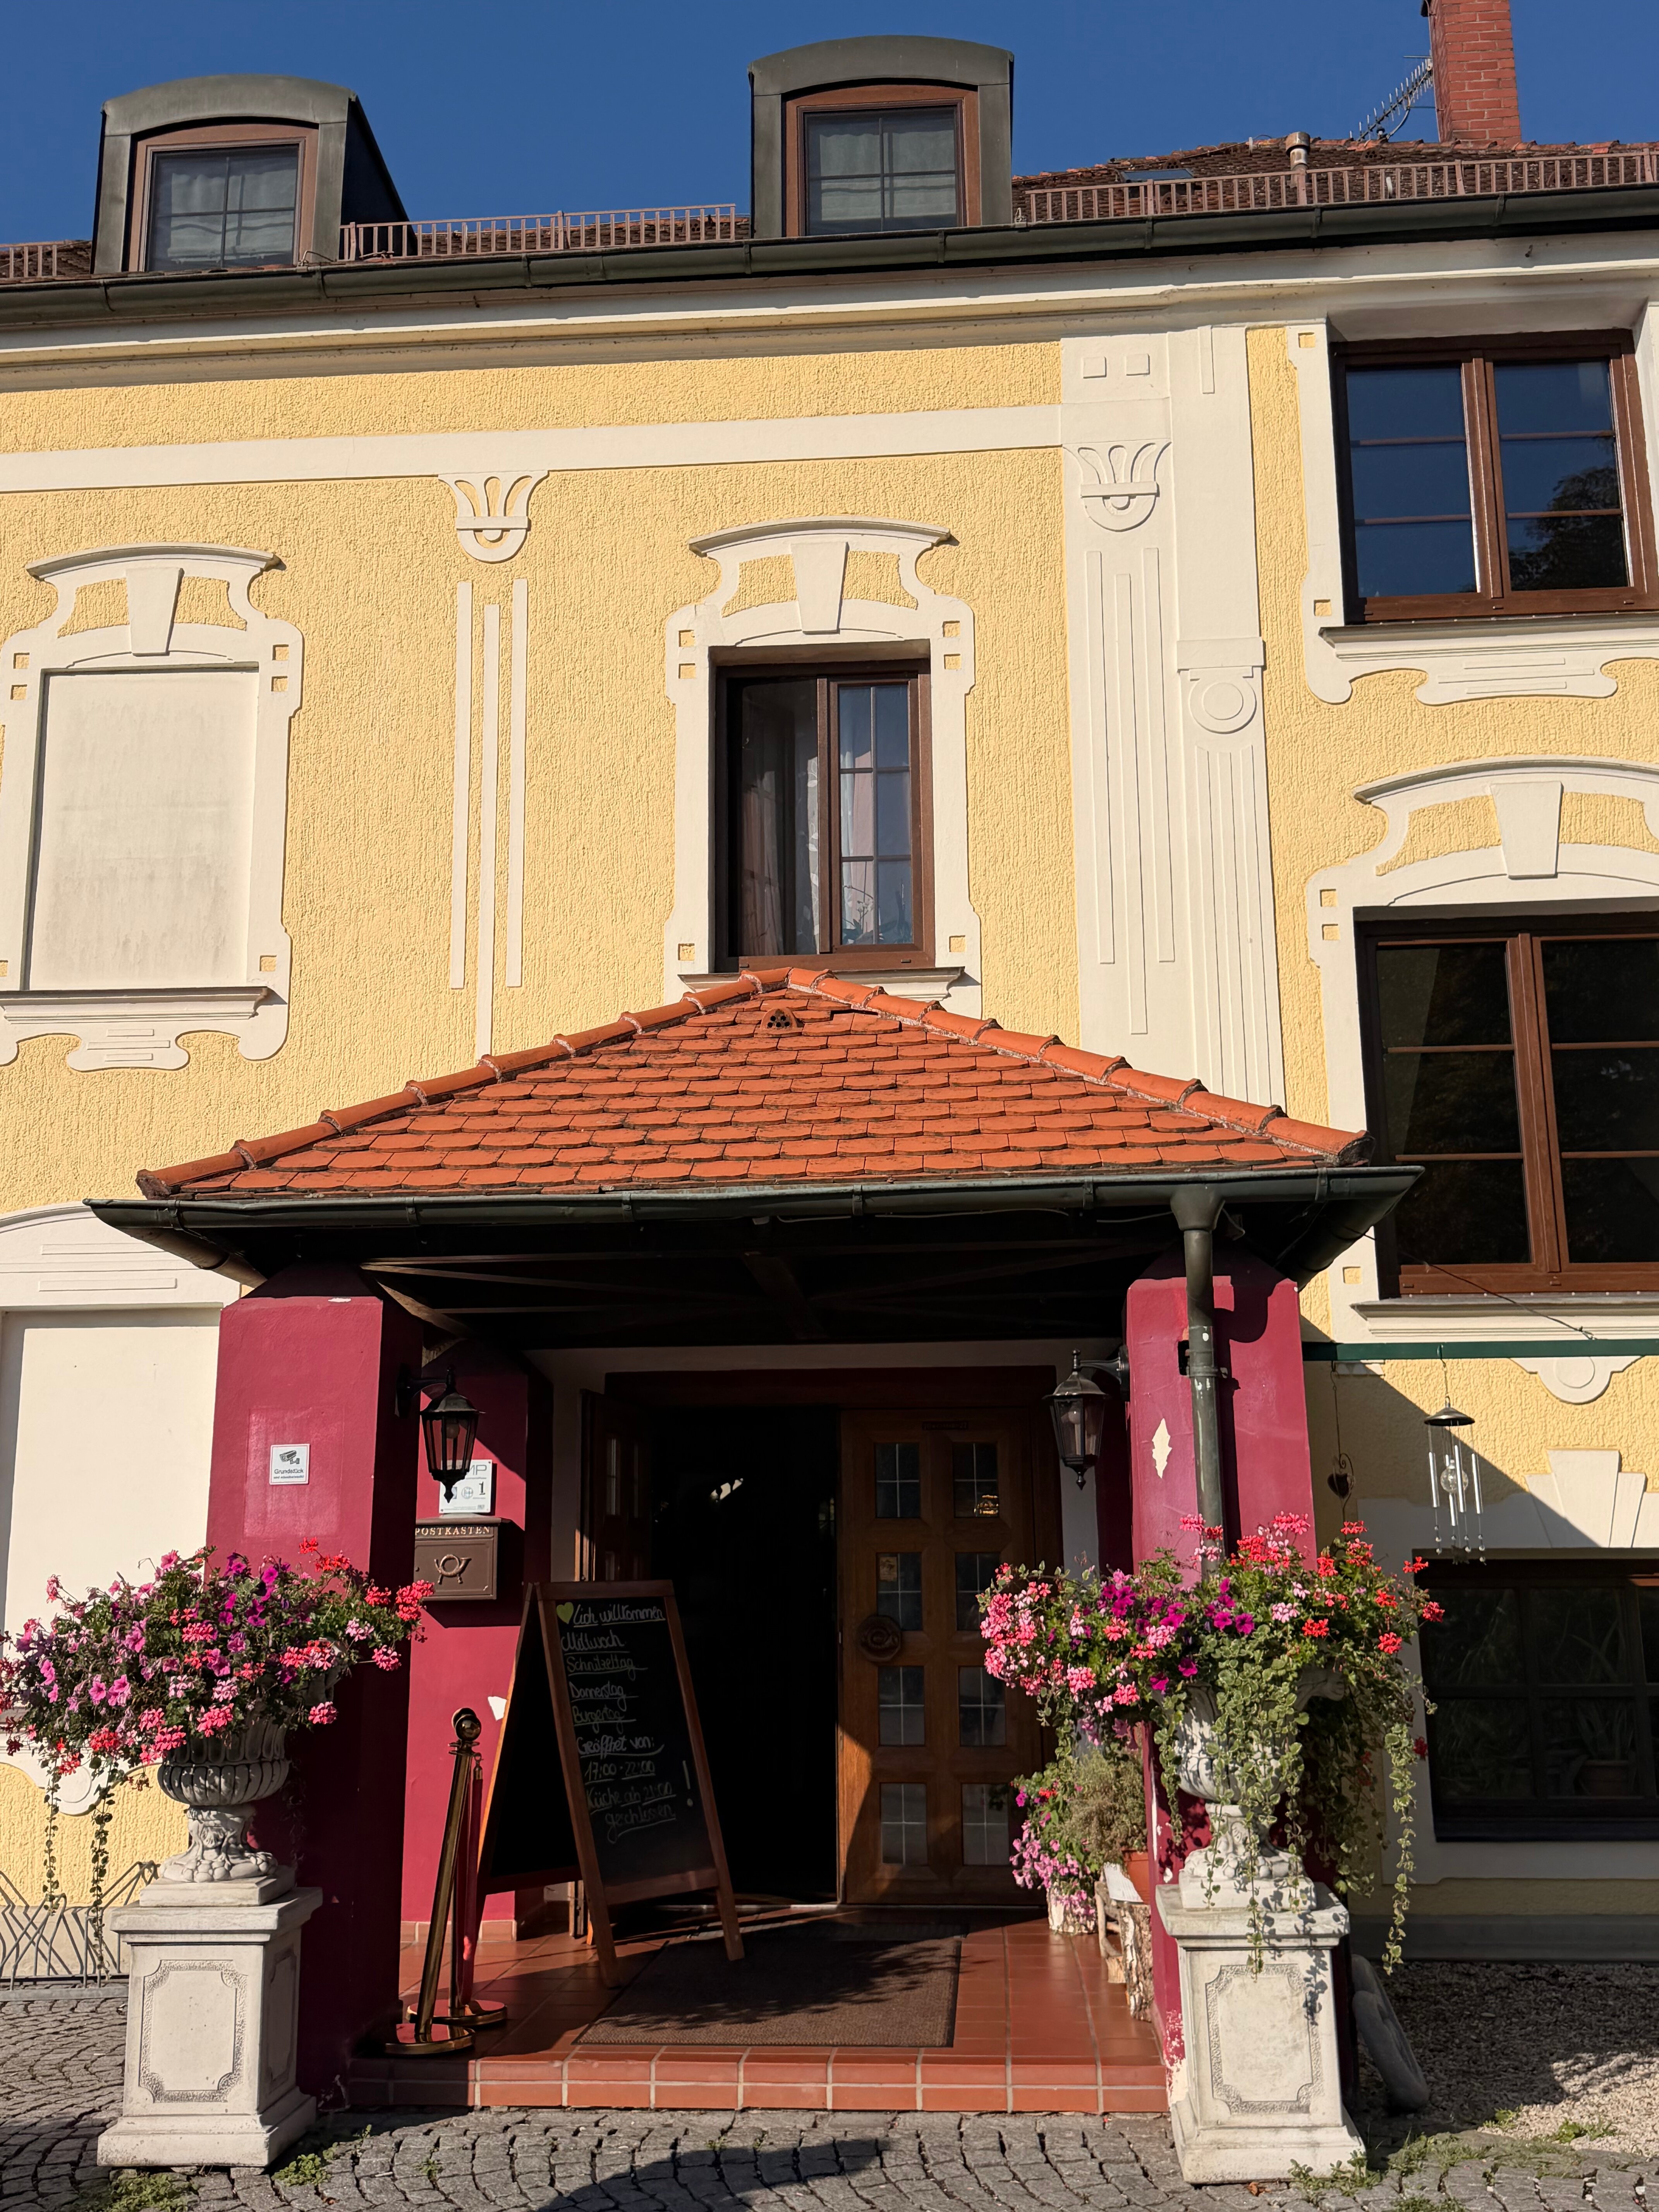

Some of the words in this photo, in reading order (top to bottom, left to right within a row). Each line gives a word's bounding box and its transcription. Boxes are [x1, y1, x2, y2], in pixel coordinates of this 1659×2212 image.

[479, 1481, 486, 1495] 1
[415, 1526, 490, 1536] POSTKASTEN
[600, 1603, 663, 1623] willkommen
[561, 1629, 625, 1652] Mittwoch
[566, 1654, 636, 1681] Schnitzeltag
[568, 1680, 627, 1712] Donnerstag
[572, 1704, 625, 1734] Burgertag
[577, 1735, 627, 1760] Geöffnet
[584, 1760, 617, 1781] 17:00
[625, 1760, 656, 1776] 22:00
[586, 1786, 622, 1809] Küche
[624, 1786, 641, 1802] ab
[643, 1781, 672, 1801] 21:00
